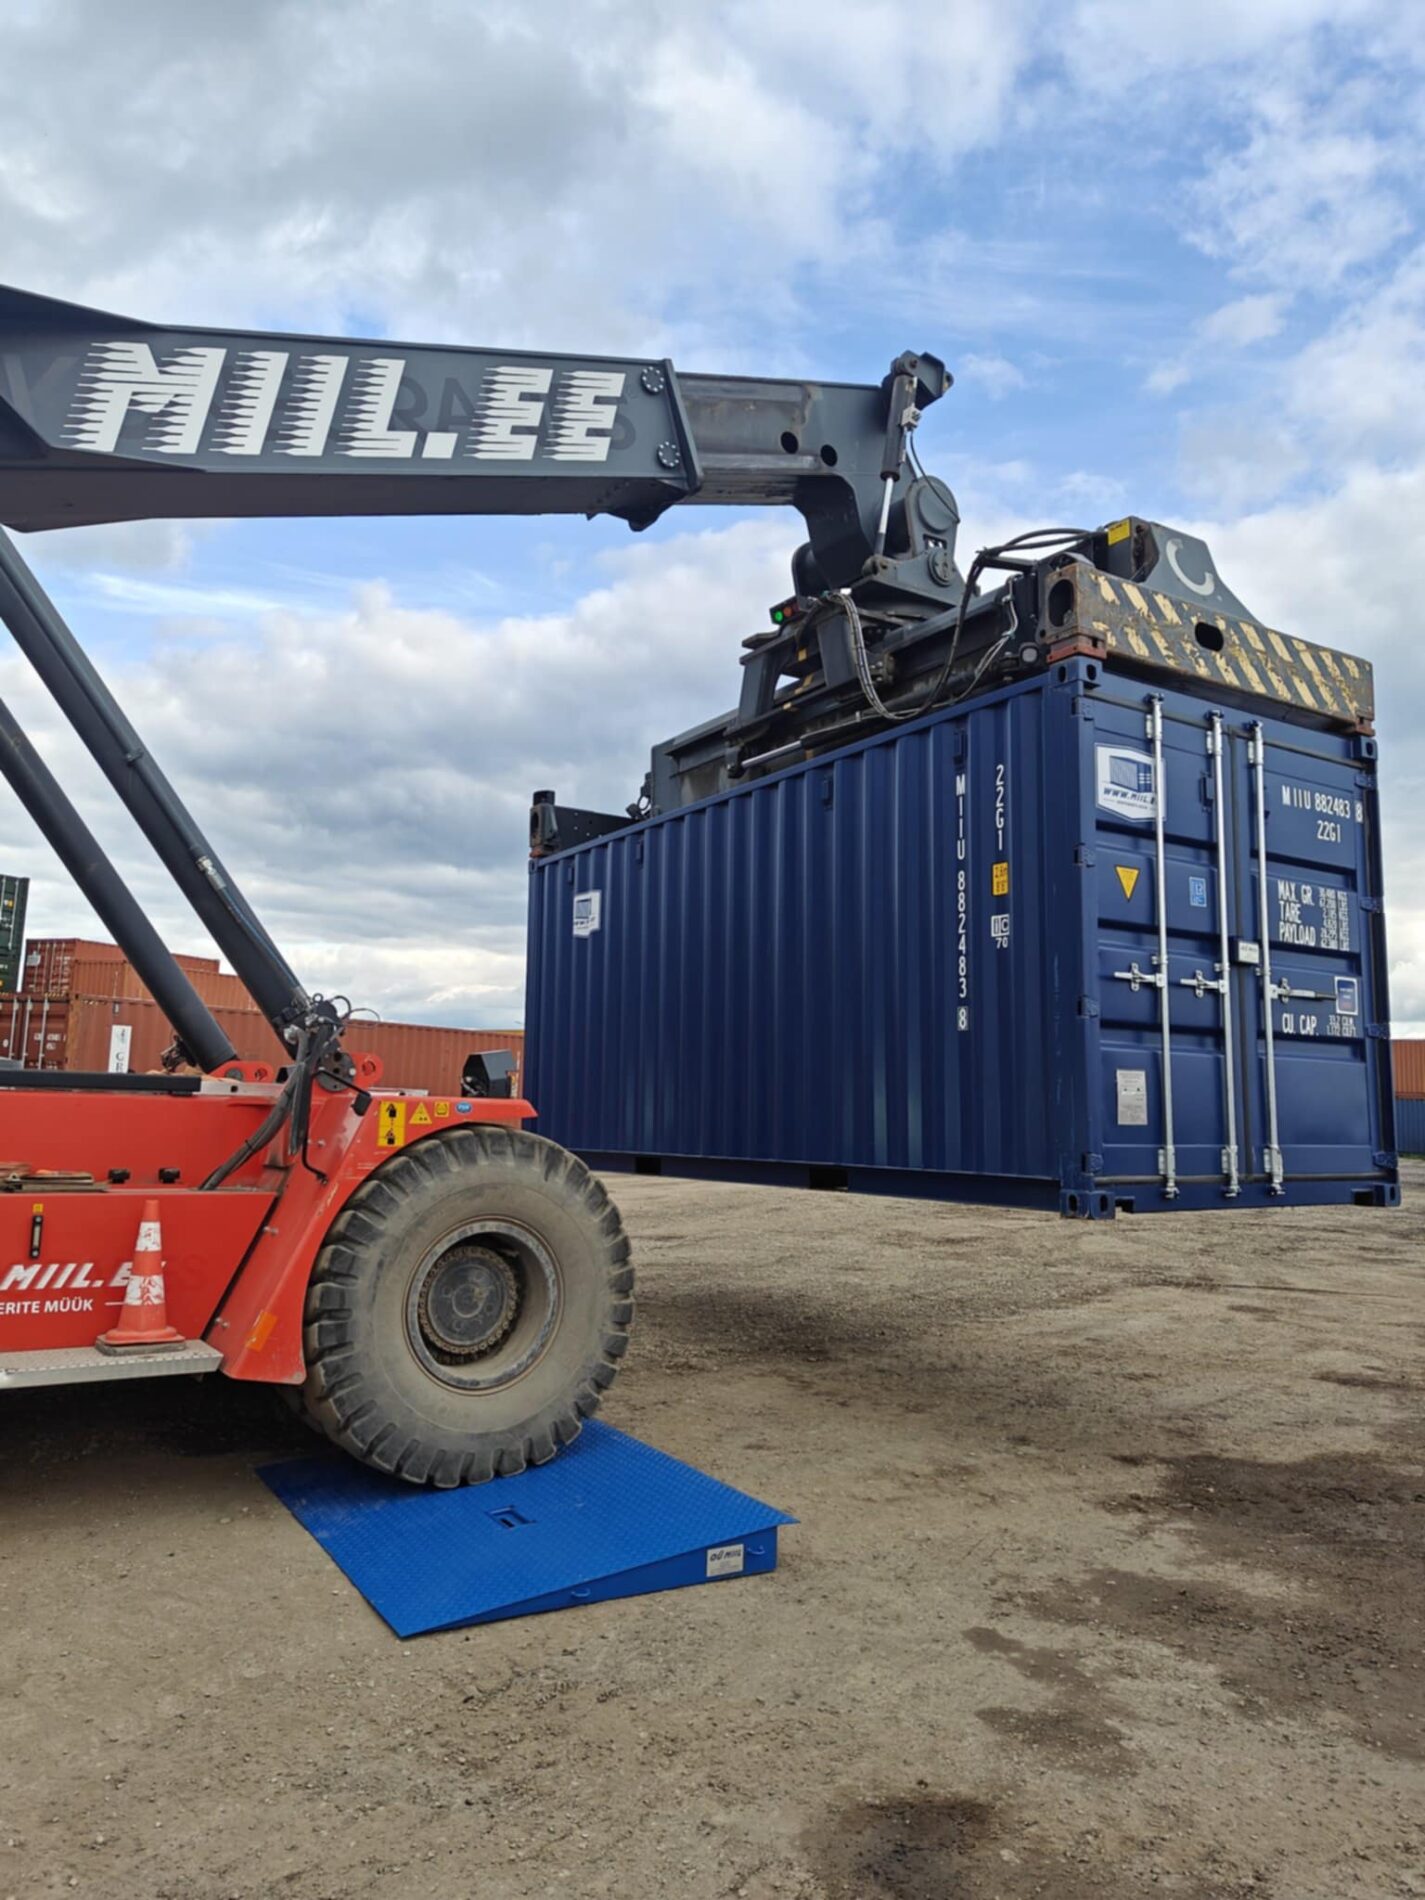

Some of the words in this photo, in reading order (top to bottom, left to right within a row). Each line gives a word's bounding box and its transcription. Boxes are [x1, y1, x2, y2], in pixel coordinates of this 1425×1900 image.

[955, 773, 966, 860] MIIU
[995, 764, 1005, 851] 22G1
[1282, 785, 1312, 810] MIIU
[1314, 792, 1351, 819] 882483
[1355, 801, 1363, 823] 8
[1316, 819, 1341, 844] 22G1
[1279, 900, 1302, 924] TARE
[957, 870, 967, 999] 882483
[1279, 920, 1317, 947] PAYLOAD
[957, 1005, 969, 1031] 8
[44, 1296, 94, 1314] MÜÜK
